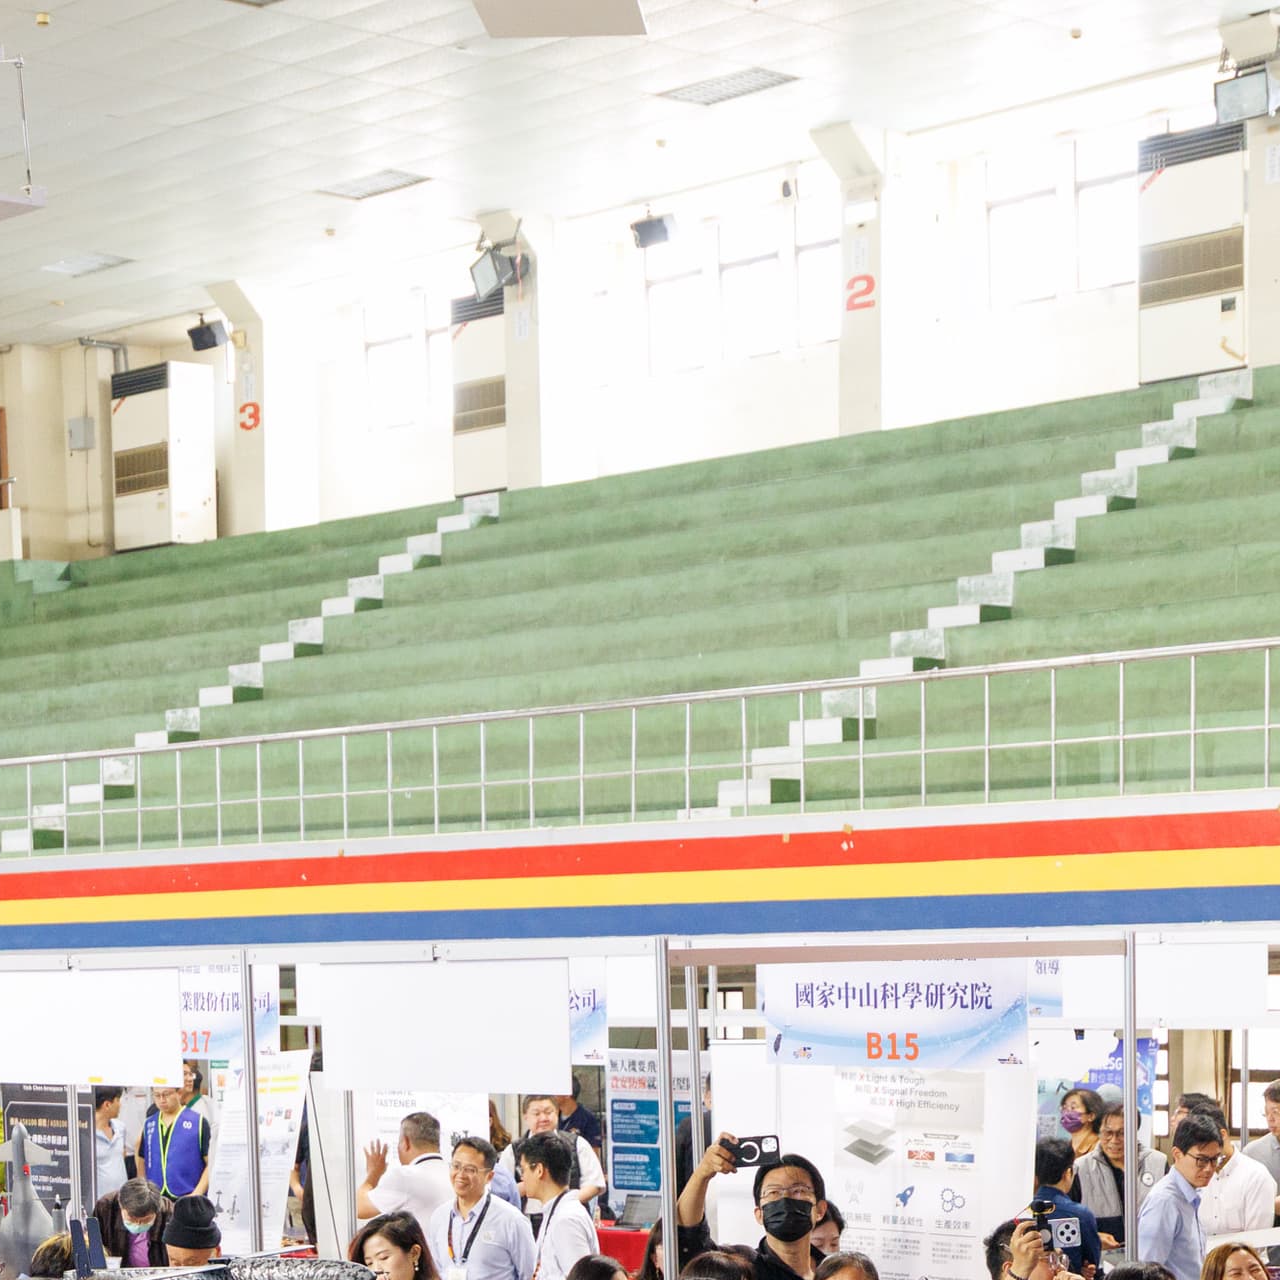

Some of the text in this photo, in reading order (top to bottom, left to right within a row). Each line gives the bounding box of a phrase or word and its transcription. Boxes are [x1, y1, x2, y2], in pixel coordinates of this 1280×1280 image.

[847, 275, 875, 311] 2
[240, 402, 260, 430] 3
[795, 981, 992, 1010] 國家中山科學研究院
[866, 1032, 920, 1060] B15
